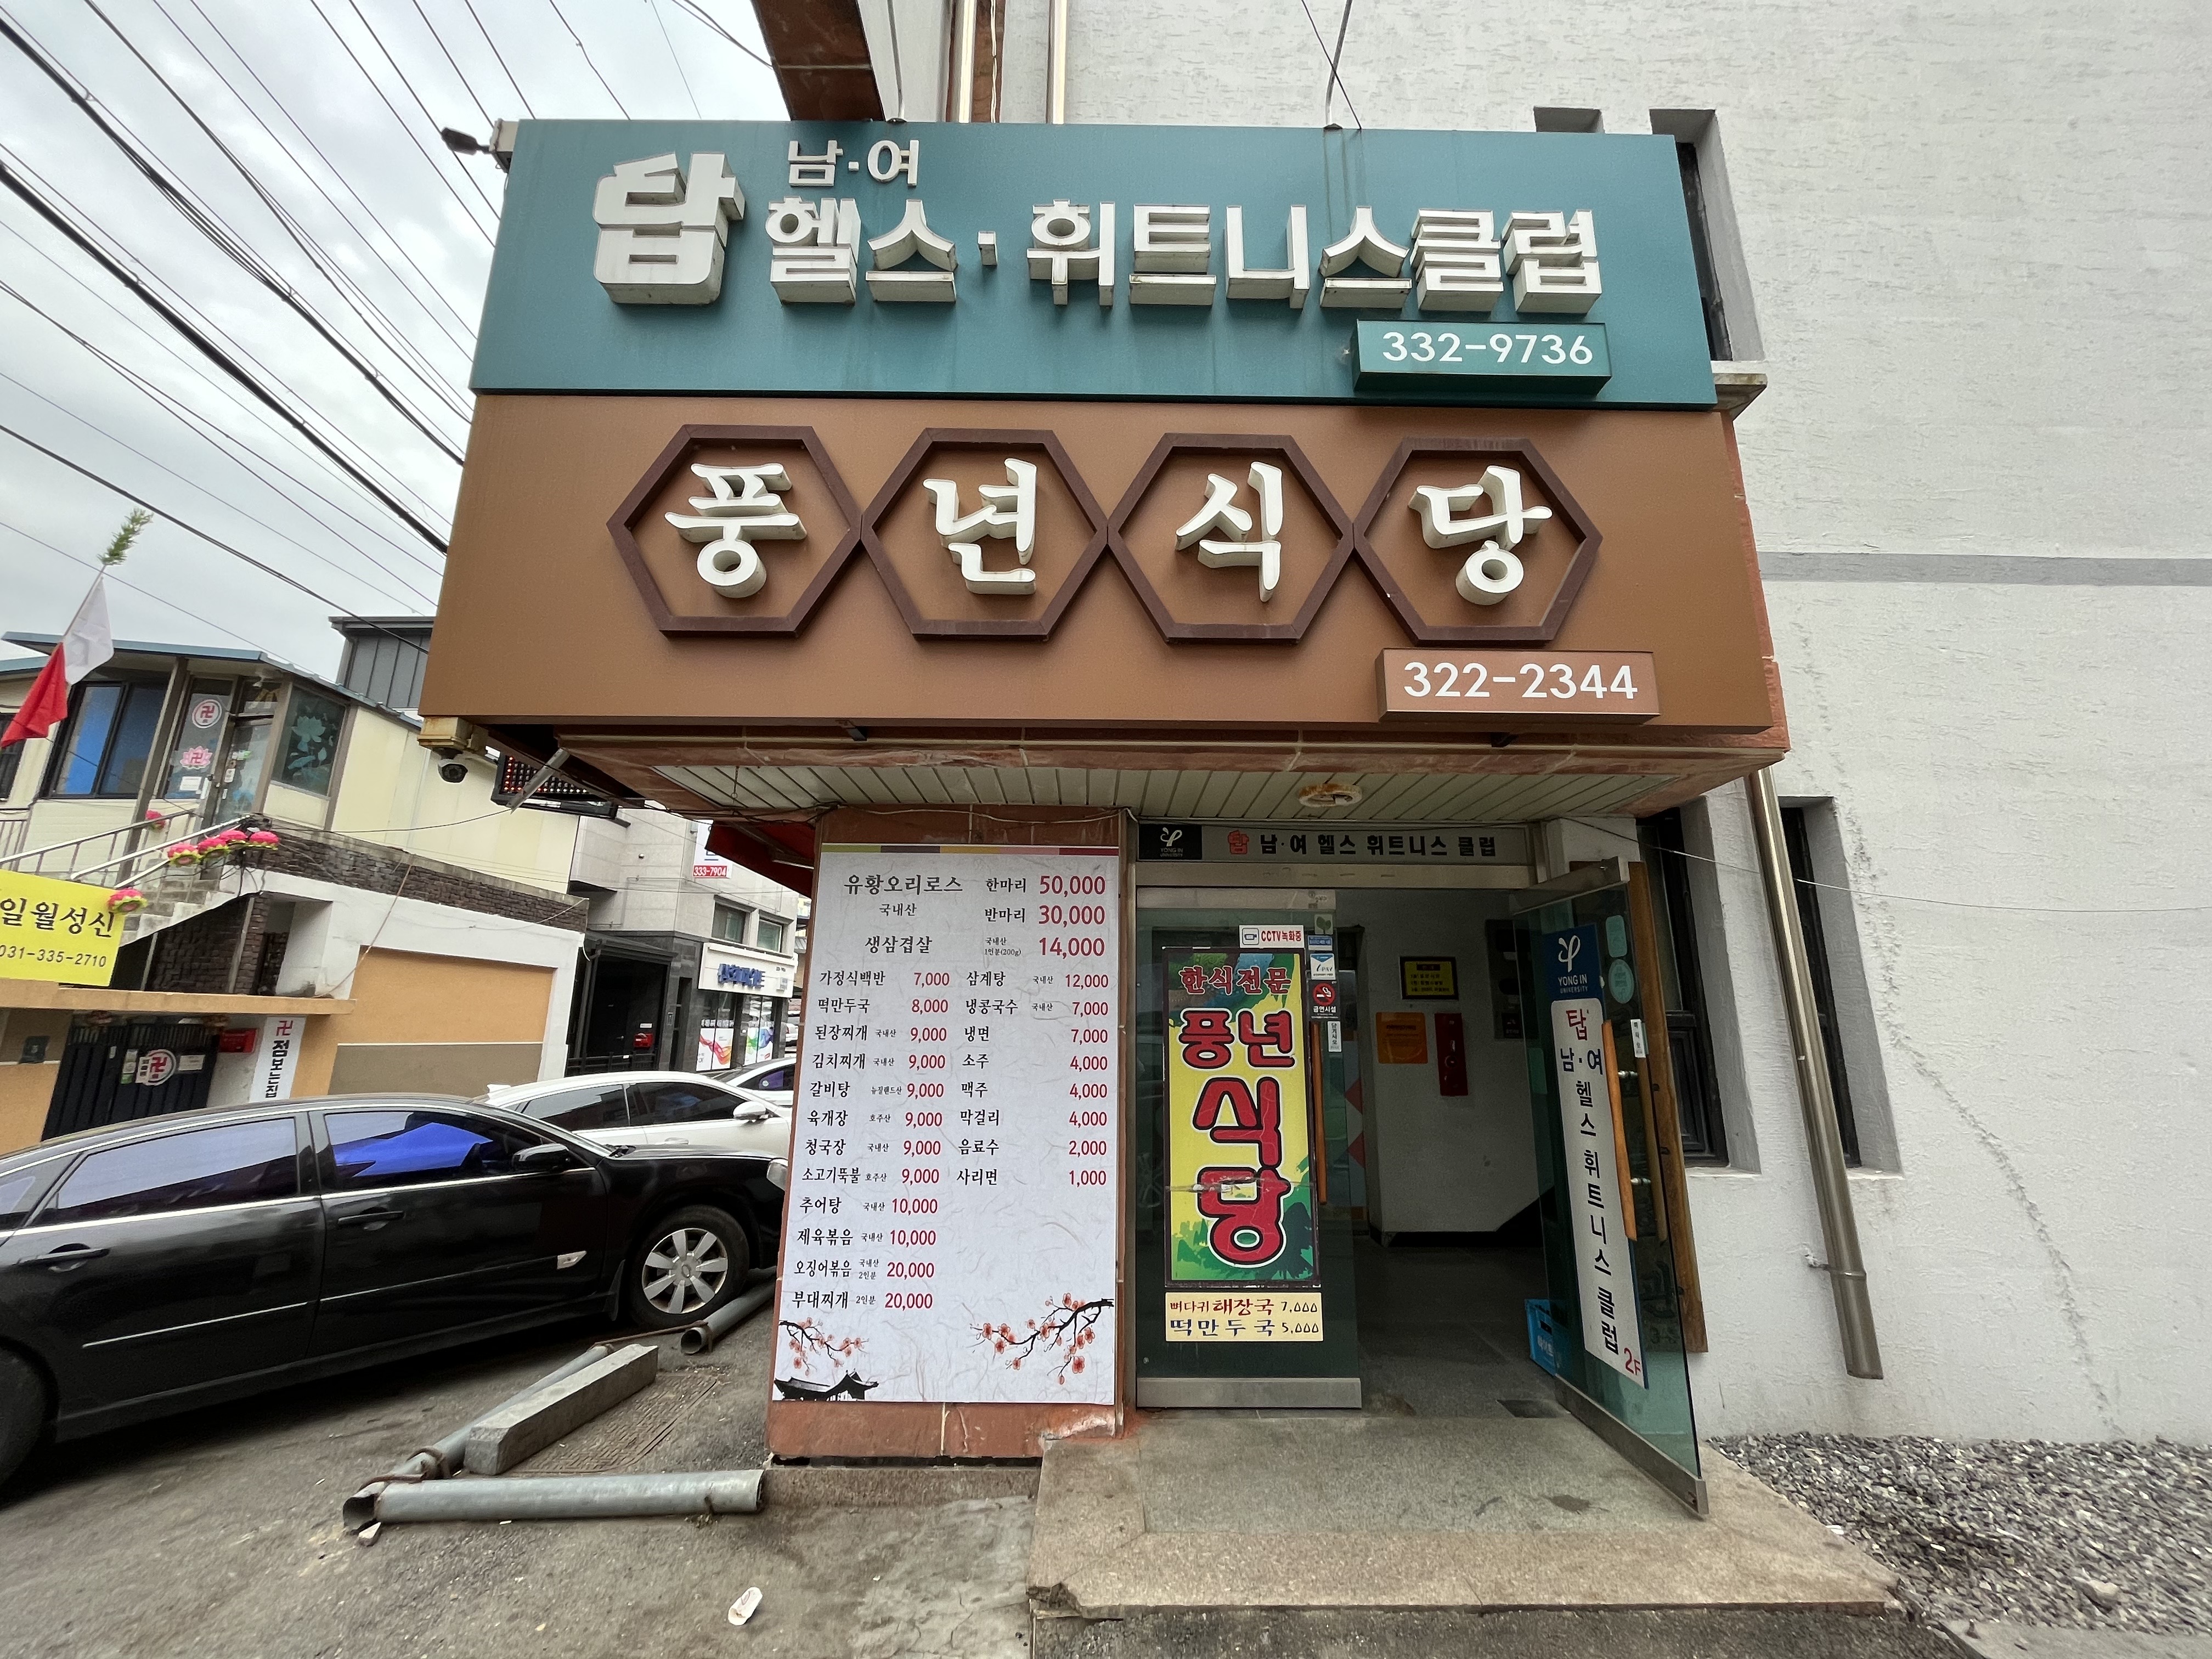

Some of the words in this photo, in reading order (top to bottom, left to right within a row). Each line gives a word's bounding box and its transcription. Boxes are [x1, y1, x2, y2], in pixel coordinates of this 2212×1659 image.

[594, 150, 745, 305] 탑
[1382, 330, 1593, 366] 332-9736
[665, 457, 1552, 605] 풍년식당
[1404, 661, 1638, 700] 322-2344
[1227, 830, 1249, 855] 탑
[1317, 834, 1356, 856] 헬스
[693, 866, 726, 876] 333-7904
[844, 874, 963, 895] 유황오리로스
[985, 877, 1026, 893] 한마리
[1040, 875, 1105, 898] 50,000
[1, 898, 114, 938] 일월성신
[879, 902, 917, 917] 국내산
[984, 907, 1025, 923] 반마리
[1039, 905, 1105, 928] 30,000
[865, 935, 933, 953] 생삼겹살
[1039, 937, 1105, 960] 14,000
[985, 936, 1006, 946] 국내산
[0, 945, 106, 967] 031-335-2710
[819, 970, 886, 986] 가정식백반
[914, 972, 950, 988] 7,000
[966, 970, 1006, 987] 삼계탕
[1032, 975, 1053, 984] 국내산
[1065, 974, 1109, 990] 12,000
[1178, 966, 1292, 996] 한식전문
[1558, 975, 1578, 986] YONG
[1579, 973, 1588, 985] IN
[817, 997, 870, 1014] 떡만두국
[911, 999, 949, 1015] 8,000
[966, 998, 1018, 1015] 냉콩국수
[1032, 1002, 1053, 1012] 국내산
[1072, 1002, 1108, 1018] 7,000
[815, 1024, 867, 1041] 된장찌개
[875, 1029, 897, 1038] 국내산
[910, 1027, 947, 1043] 9,000
[1566, 1008, 1588, 1041] 탑
[964, 1025, 989, 1042] 냉면
[1071, 1029, 1108, 1046] 7,000
[812, 1052, 866, 1070] 김치찌개
[873, 1057, 895, 1066] 국내산
[909, 1054, 945, 1071] 9,000
[962, 1054, 989, 1069] 소주
[1070, 1056, 1108, 1073] 4,000
[810, 1081, 851, 1098] 갈비탕
[907, 1083, 944, 1100] 9,000
[961, 1081, 988, 1098] 맥주
[1069, 1083, 1108, 1101] 4,000
[806, 1109, 849, 1127] 육개장
[869, 1114, 891, 1123] 호주산
[905, 1112, 943, 1129] 9,000
[960, 1109, 999, 1126] 막걸리
[1069, 1111, 1107, 1128] 4,000
[805, 1138, 847, 1155] 청국장
[867, 1143, 889, 1152] 국내산
[904, 1140, 941, 1158] 9,000
[958, 1138, 1000, 1156] 음료수
[1069, 1140, 1107, 1158] 2,000
[802, 1166, 861, 1184] 소고기뚝불
[865, 1172, 887, 1182] 호주산
[901, 1168, 939, 1186] 9,000
[956, 1168, 997, 1186] 사리면
[1069, 1170, 1107, 1188] 1,000
[799, 1197, 842, 1214] 추어탕
[863, 1201, 885, 1212] 국내산
[892, 1198, 938, 1216] 10,000
[797, 1228, 854, 1246] 제육볶음
[861, 1232, 883, 1242] 국내산
[890, 1229, 936, 1248] 10,000
[794, 1259, 852, 1278] 오징어볶음
[887, 1262, 934, 1280] 20,000
[860, 1259, 879, 1268] 국내산
[858, 1271, 876, 1280] 2인분
[792, 1290, 848, 1310] 부대찌개
[855, 1295, 876, 1305] 2인분
[884, 1293, 933, 1311] 20,000
[1623, 1347, 1641, 1375] 2F
